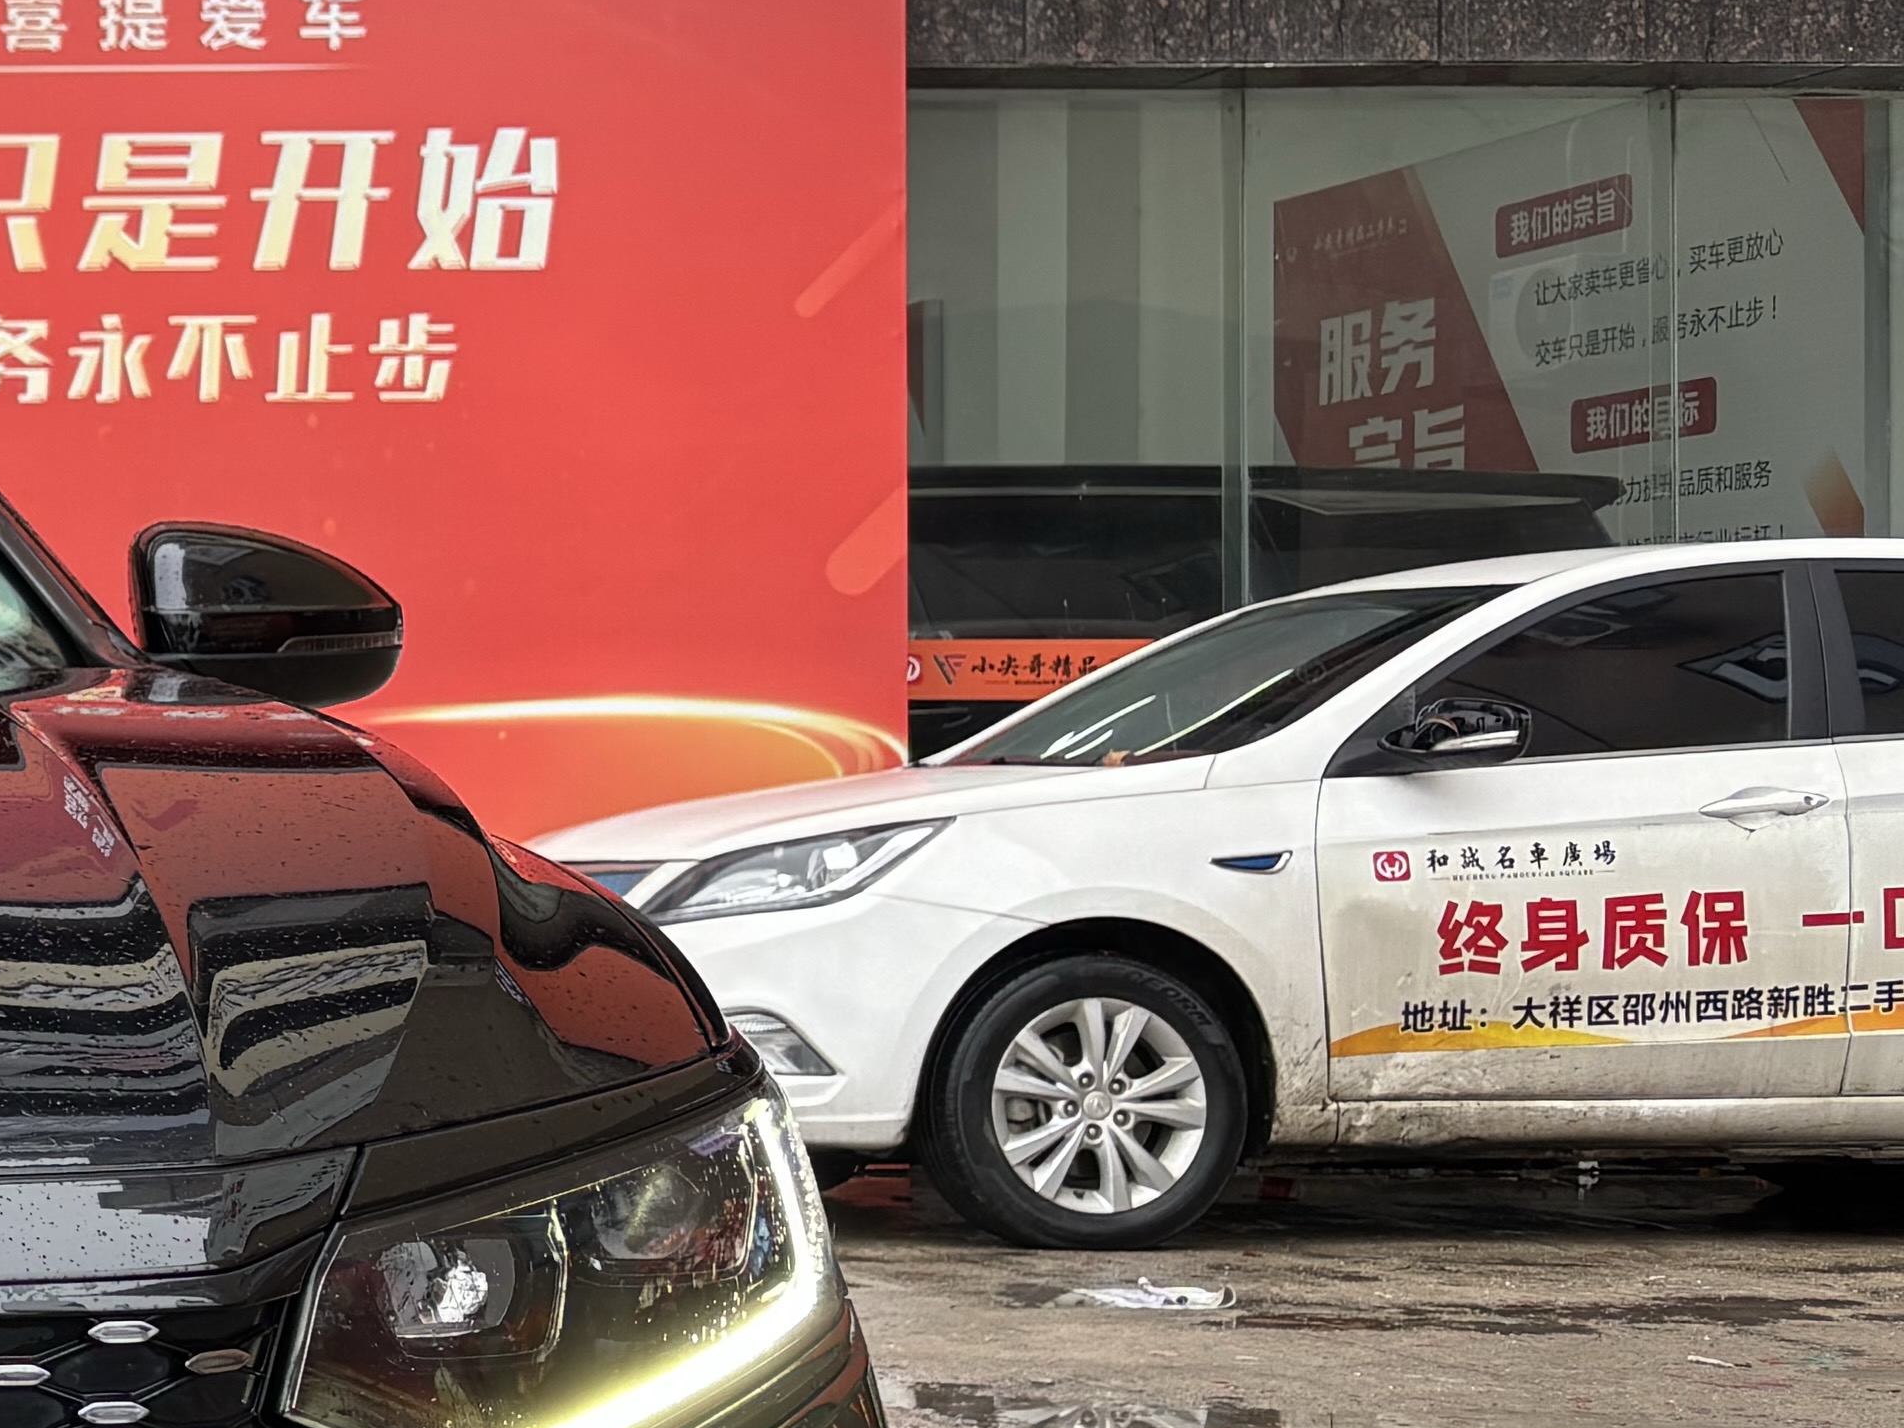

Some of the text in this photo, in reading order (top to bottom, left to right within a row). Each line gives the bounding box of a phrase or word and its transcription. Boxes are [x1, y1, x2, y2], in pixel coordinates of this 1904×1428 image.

[1509, 188, 1618, 247] 我们的宗旨
[1318, 297, 1438, 407] 服务
[1436, 889, 1749, 976] 终身质保
